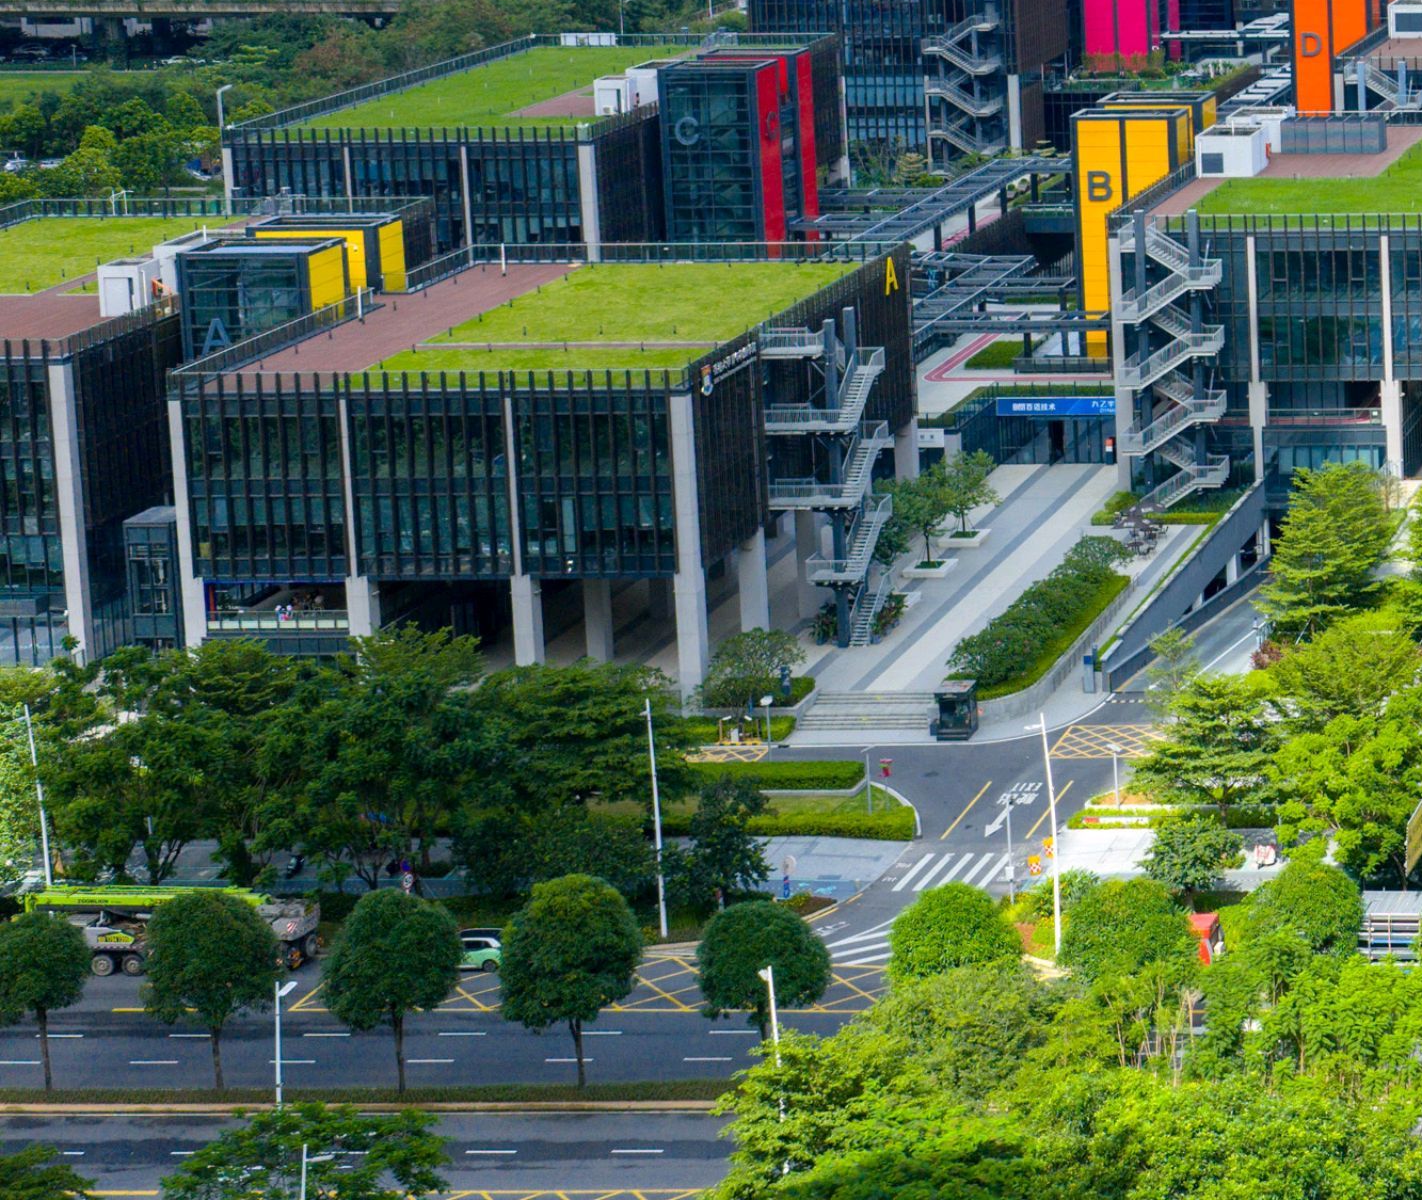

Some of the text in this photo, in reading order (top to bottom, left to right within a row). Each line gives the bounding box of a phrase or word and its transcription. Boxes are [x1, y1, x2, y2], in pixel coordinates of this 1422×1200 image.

[1301, 33, 1321, 58] D
[675, 116, 700, 146] C
[1088, 171, 1113, 202] B
[885, 256, 899, 296] A
[201, 318, 232, 359] A
